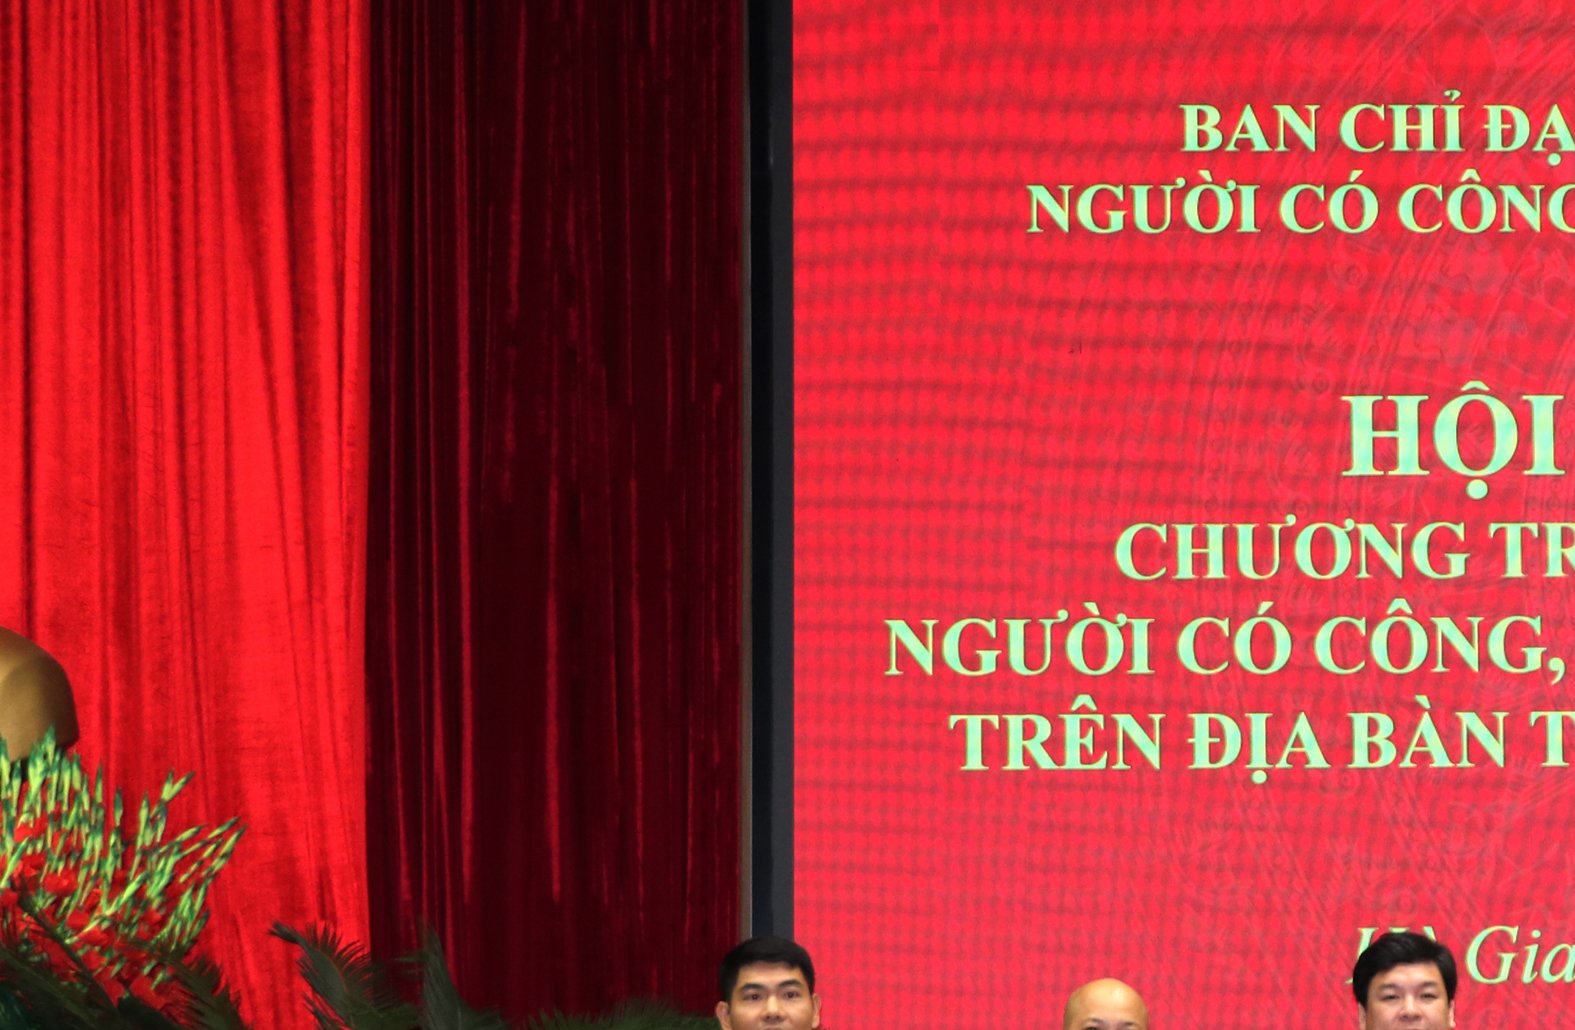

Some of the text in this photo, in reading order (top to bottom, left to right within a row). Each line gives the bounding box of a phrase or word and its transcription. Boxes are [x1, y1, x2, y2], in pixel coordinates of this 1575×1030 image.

[1179, 104, 1320, 152] BAN
[1339, 90, 1464, 152] CHỈ
[1027, 170, 1260, 233] NGƯỜI
[1279, 170, 1378, 233] CÓ
[1341, 380, 1565, 499] HỘI
[1114, 514, 1470, 580] CHƯƠNG
[884, 602, 1155, 676] NGƯỜI
[1177, 601, 1292, 675] CÓ
[1314, 598, 1565, 685] CÔNG,
[948, 694, 1166, 770] TRÊN
[1187, 712, 1331, 784] ĐỊA
[1347, 695, 1509, 768] BÀN
